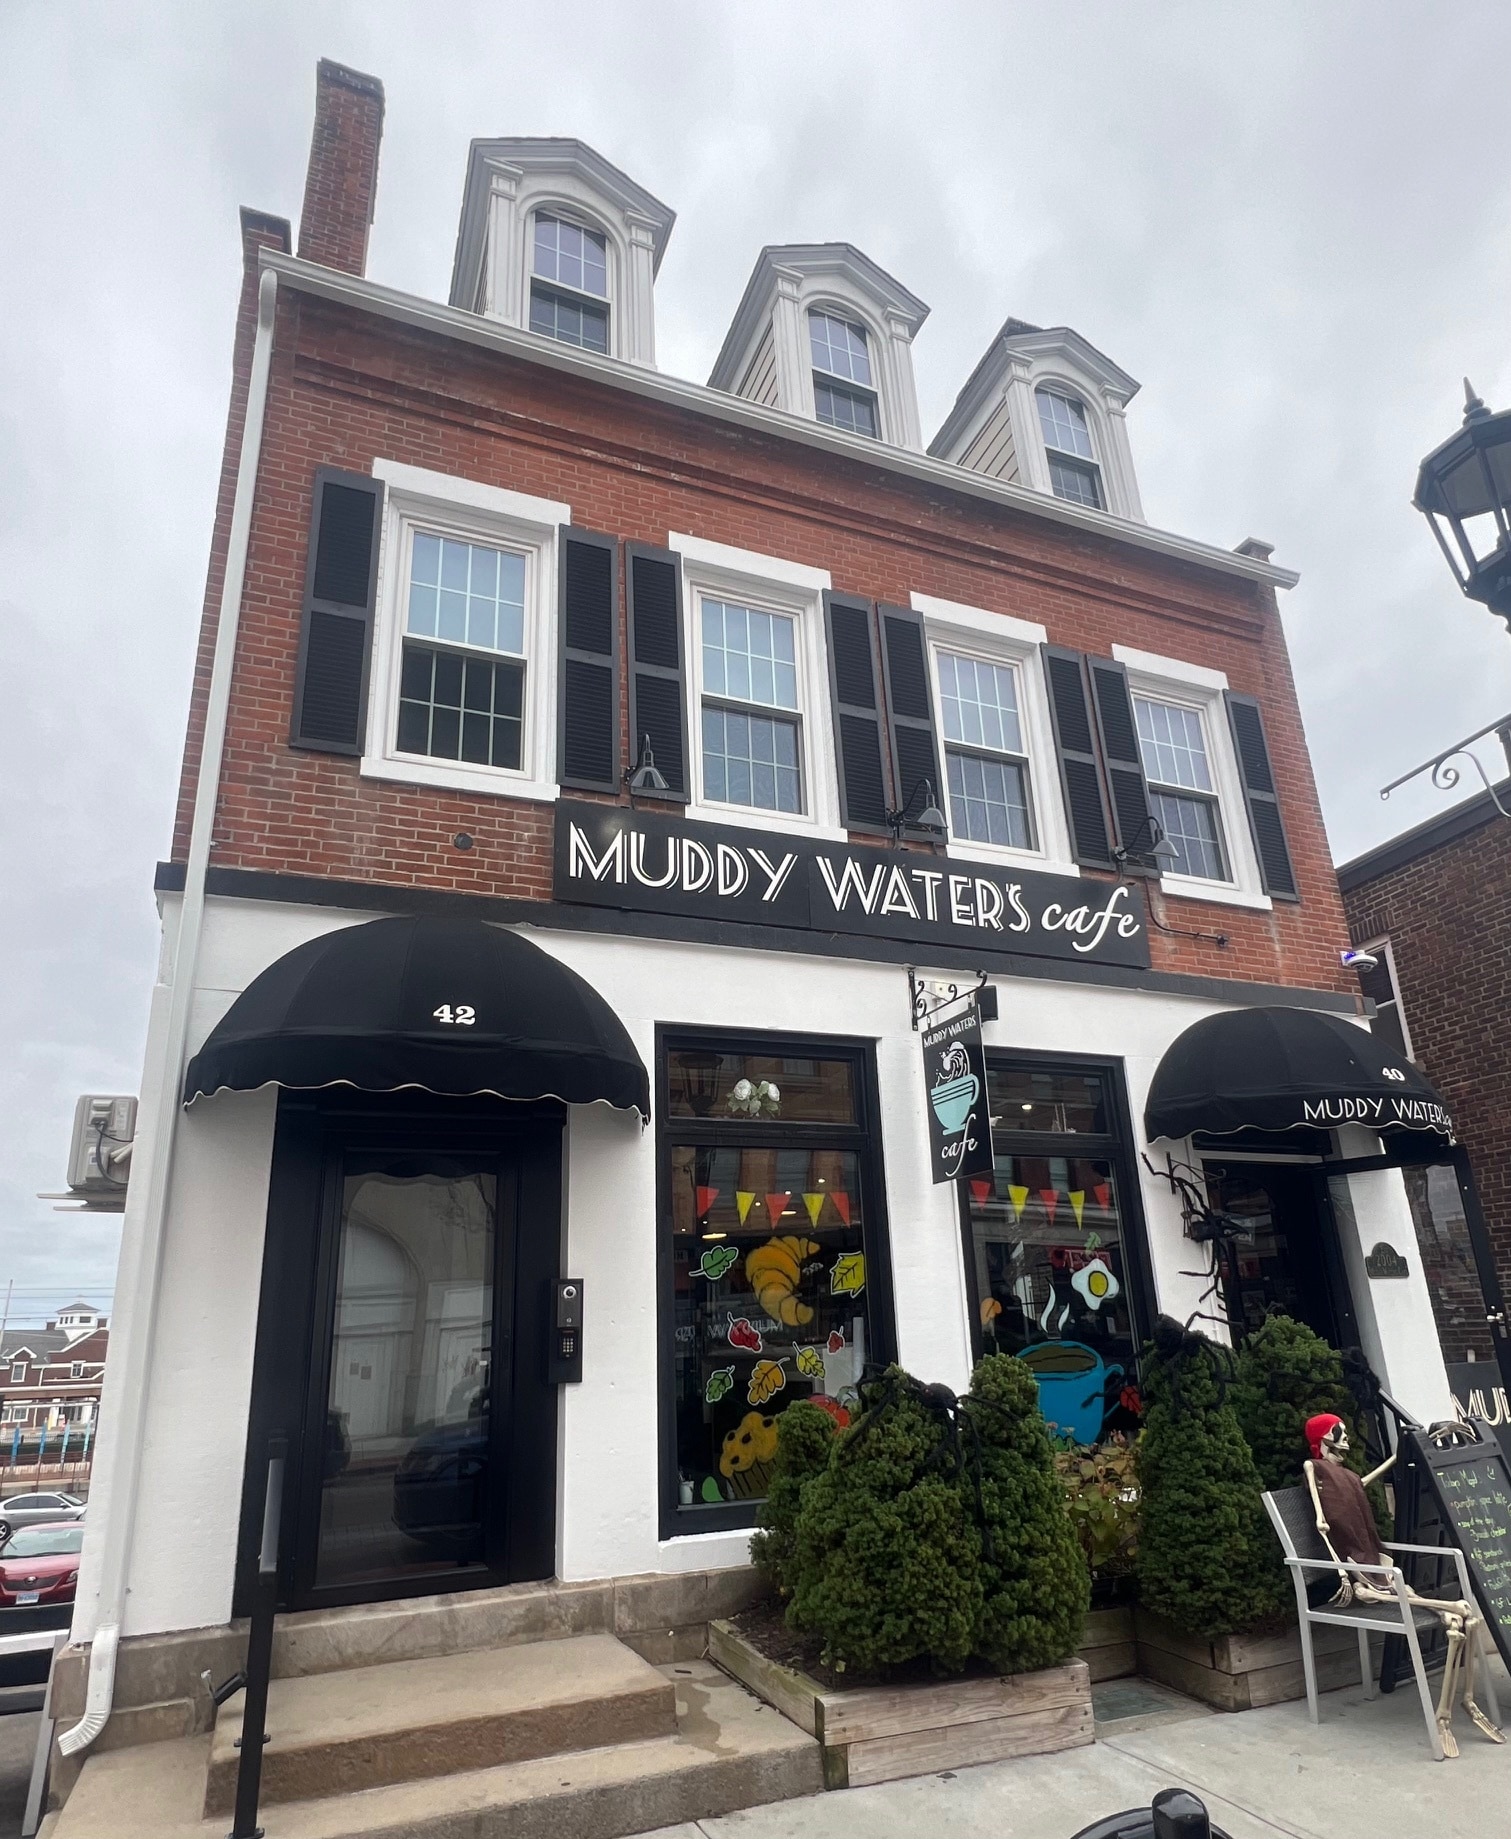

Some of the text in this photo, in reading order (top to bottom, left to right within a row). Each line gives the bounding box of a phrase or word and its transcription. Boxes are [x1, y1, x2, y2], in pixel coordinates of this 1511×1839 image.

[569, 821, 798, 901] MUDDY
[1041, 886, 1140, 952] cafe
[433, 1004, 476, 1025] 42
[924, 1014, 977, 1048] MUDDY WATERS
[1382, 1067, 1405, 1082] 40
[1303, 1098, 1383, 1120] MUDDY
[941, 1113, 978, 1176] cafe
